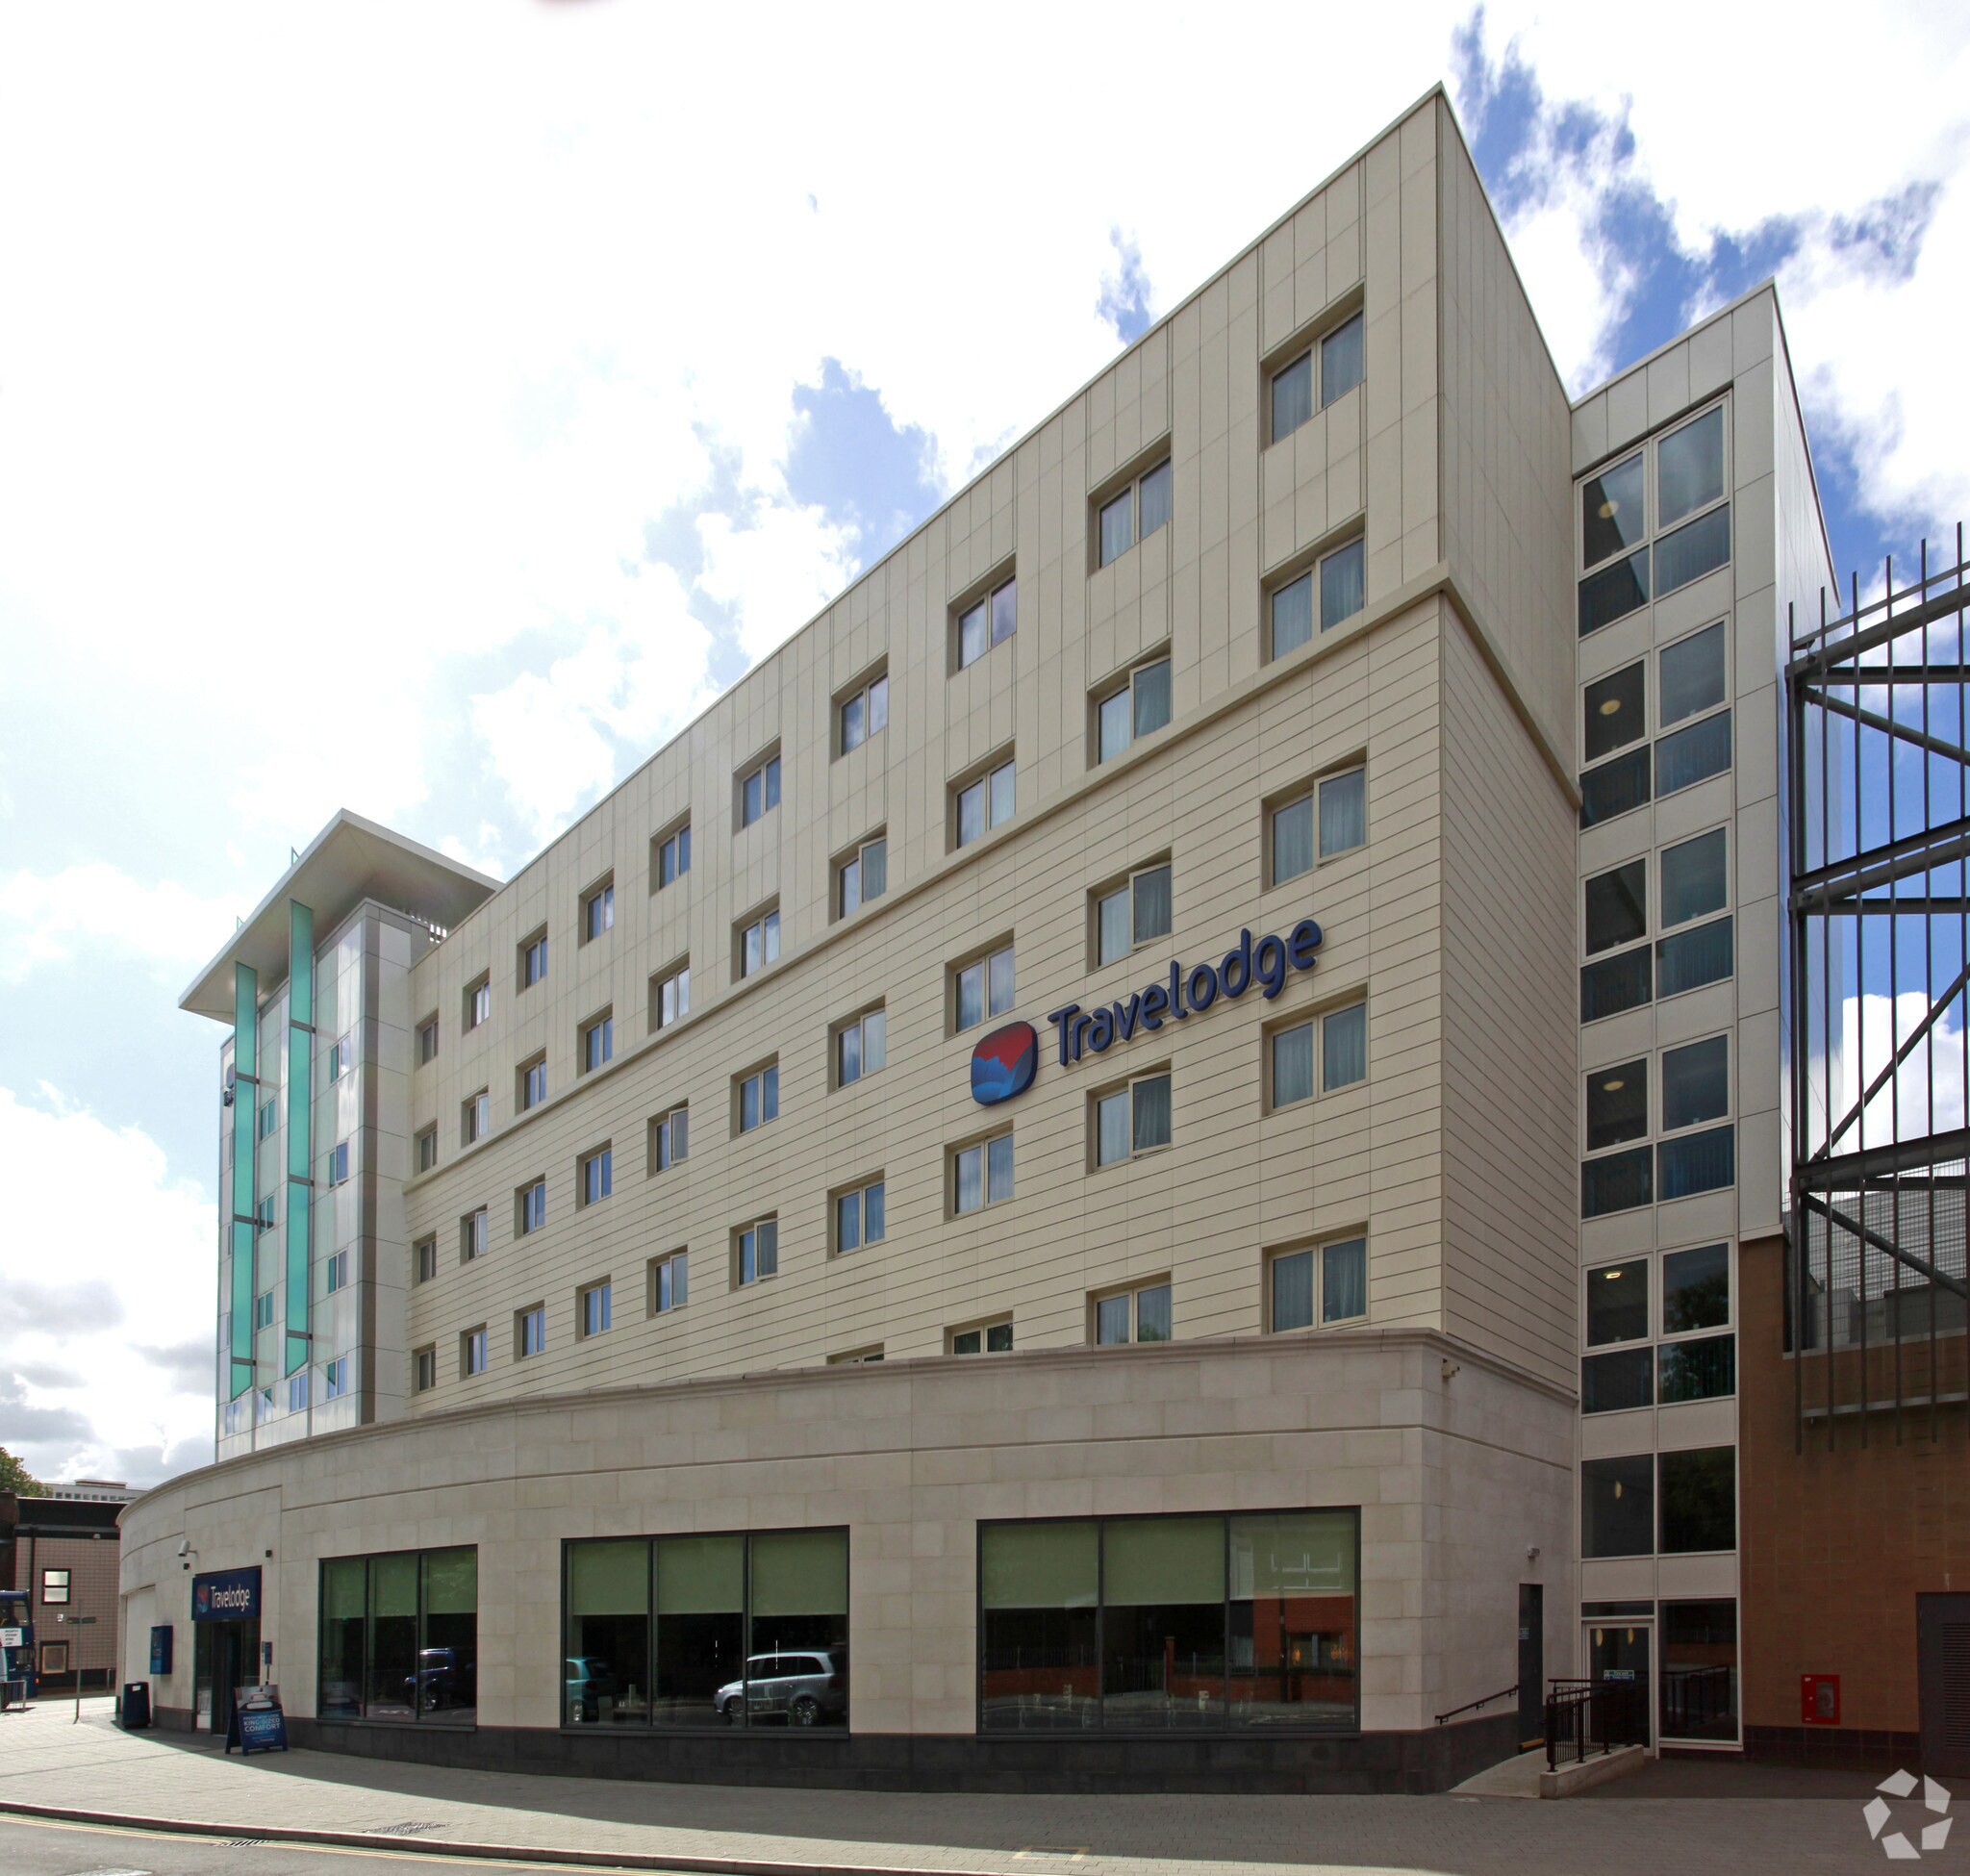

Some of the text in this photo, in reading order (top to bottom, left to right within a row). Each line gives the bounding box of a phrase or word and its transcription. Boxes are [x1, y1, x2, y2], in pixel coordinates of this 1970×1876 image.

[1048, 919, 1323, 1067] Travelodge
[210, 1583, 250, 1612] Travelodge
[244, 1723, 281, 1732] COMFORT
